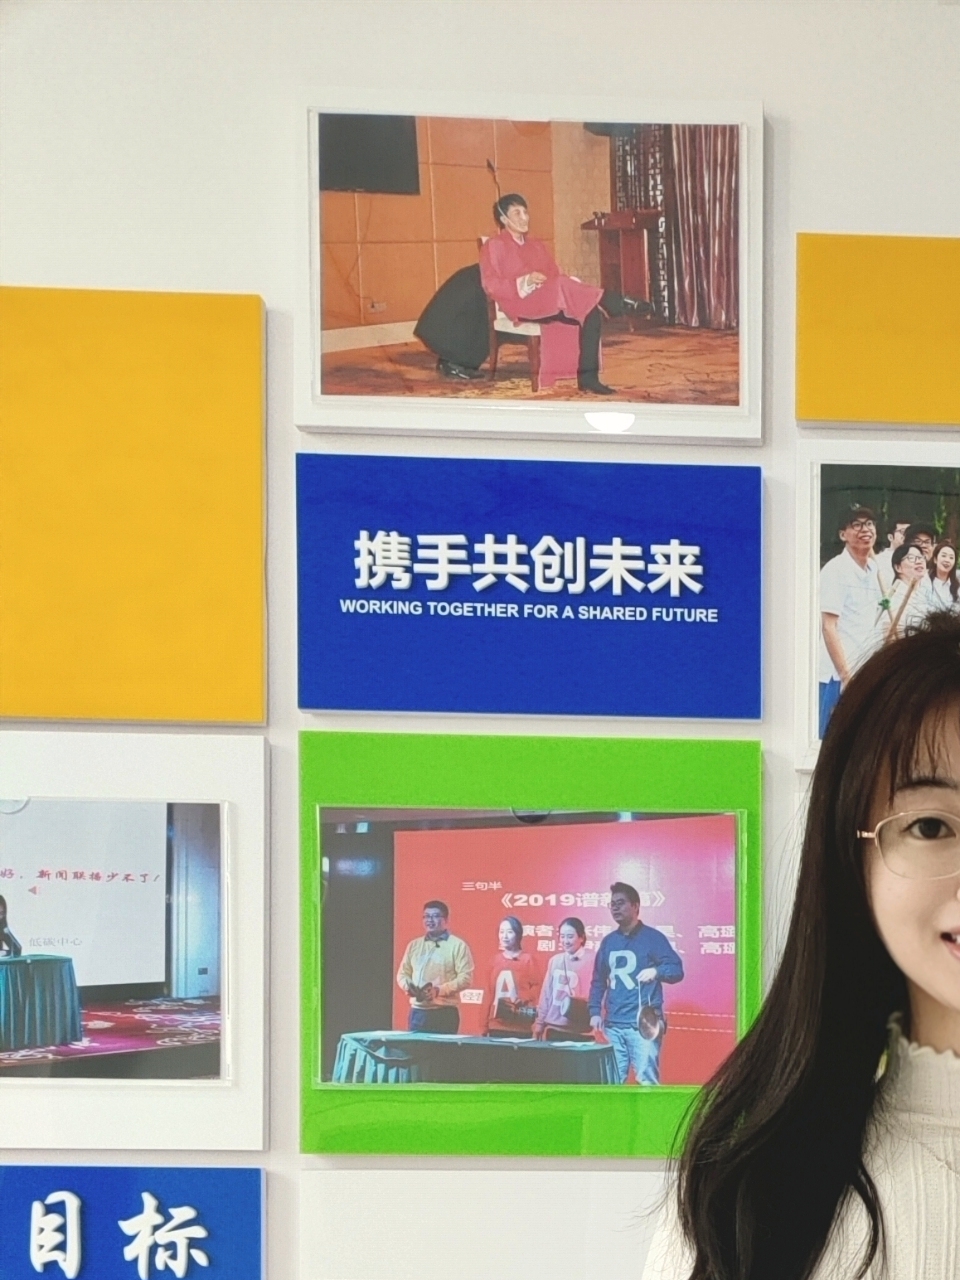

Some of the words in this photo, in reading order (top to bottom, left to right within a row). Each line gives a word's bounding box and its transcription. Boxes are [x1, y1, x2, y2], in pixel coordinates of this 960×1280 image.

[354, 530, 704, 597] 携手共创未来
[340, 599, 423, 615] WORKING
[427, 602, 519, 618] TOGETHER
[524, 604, 558, 619] FOR
[562, 605, 574, 619] A
[578, 605, 647, 621] SHARED
[652, 607, 718, 623] FUTURE
[608, 949, 637, 990] R
[29, 1190, 209, 1280] 目标
